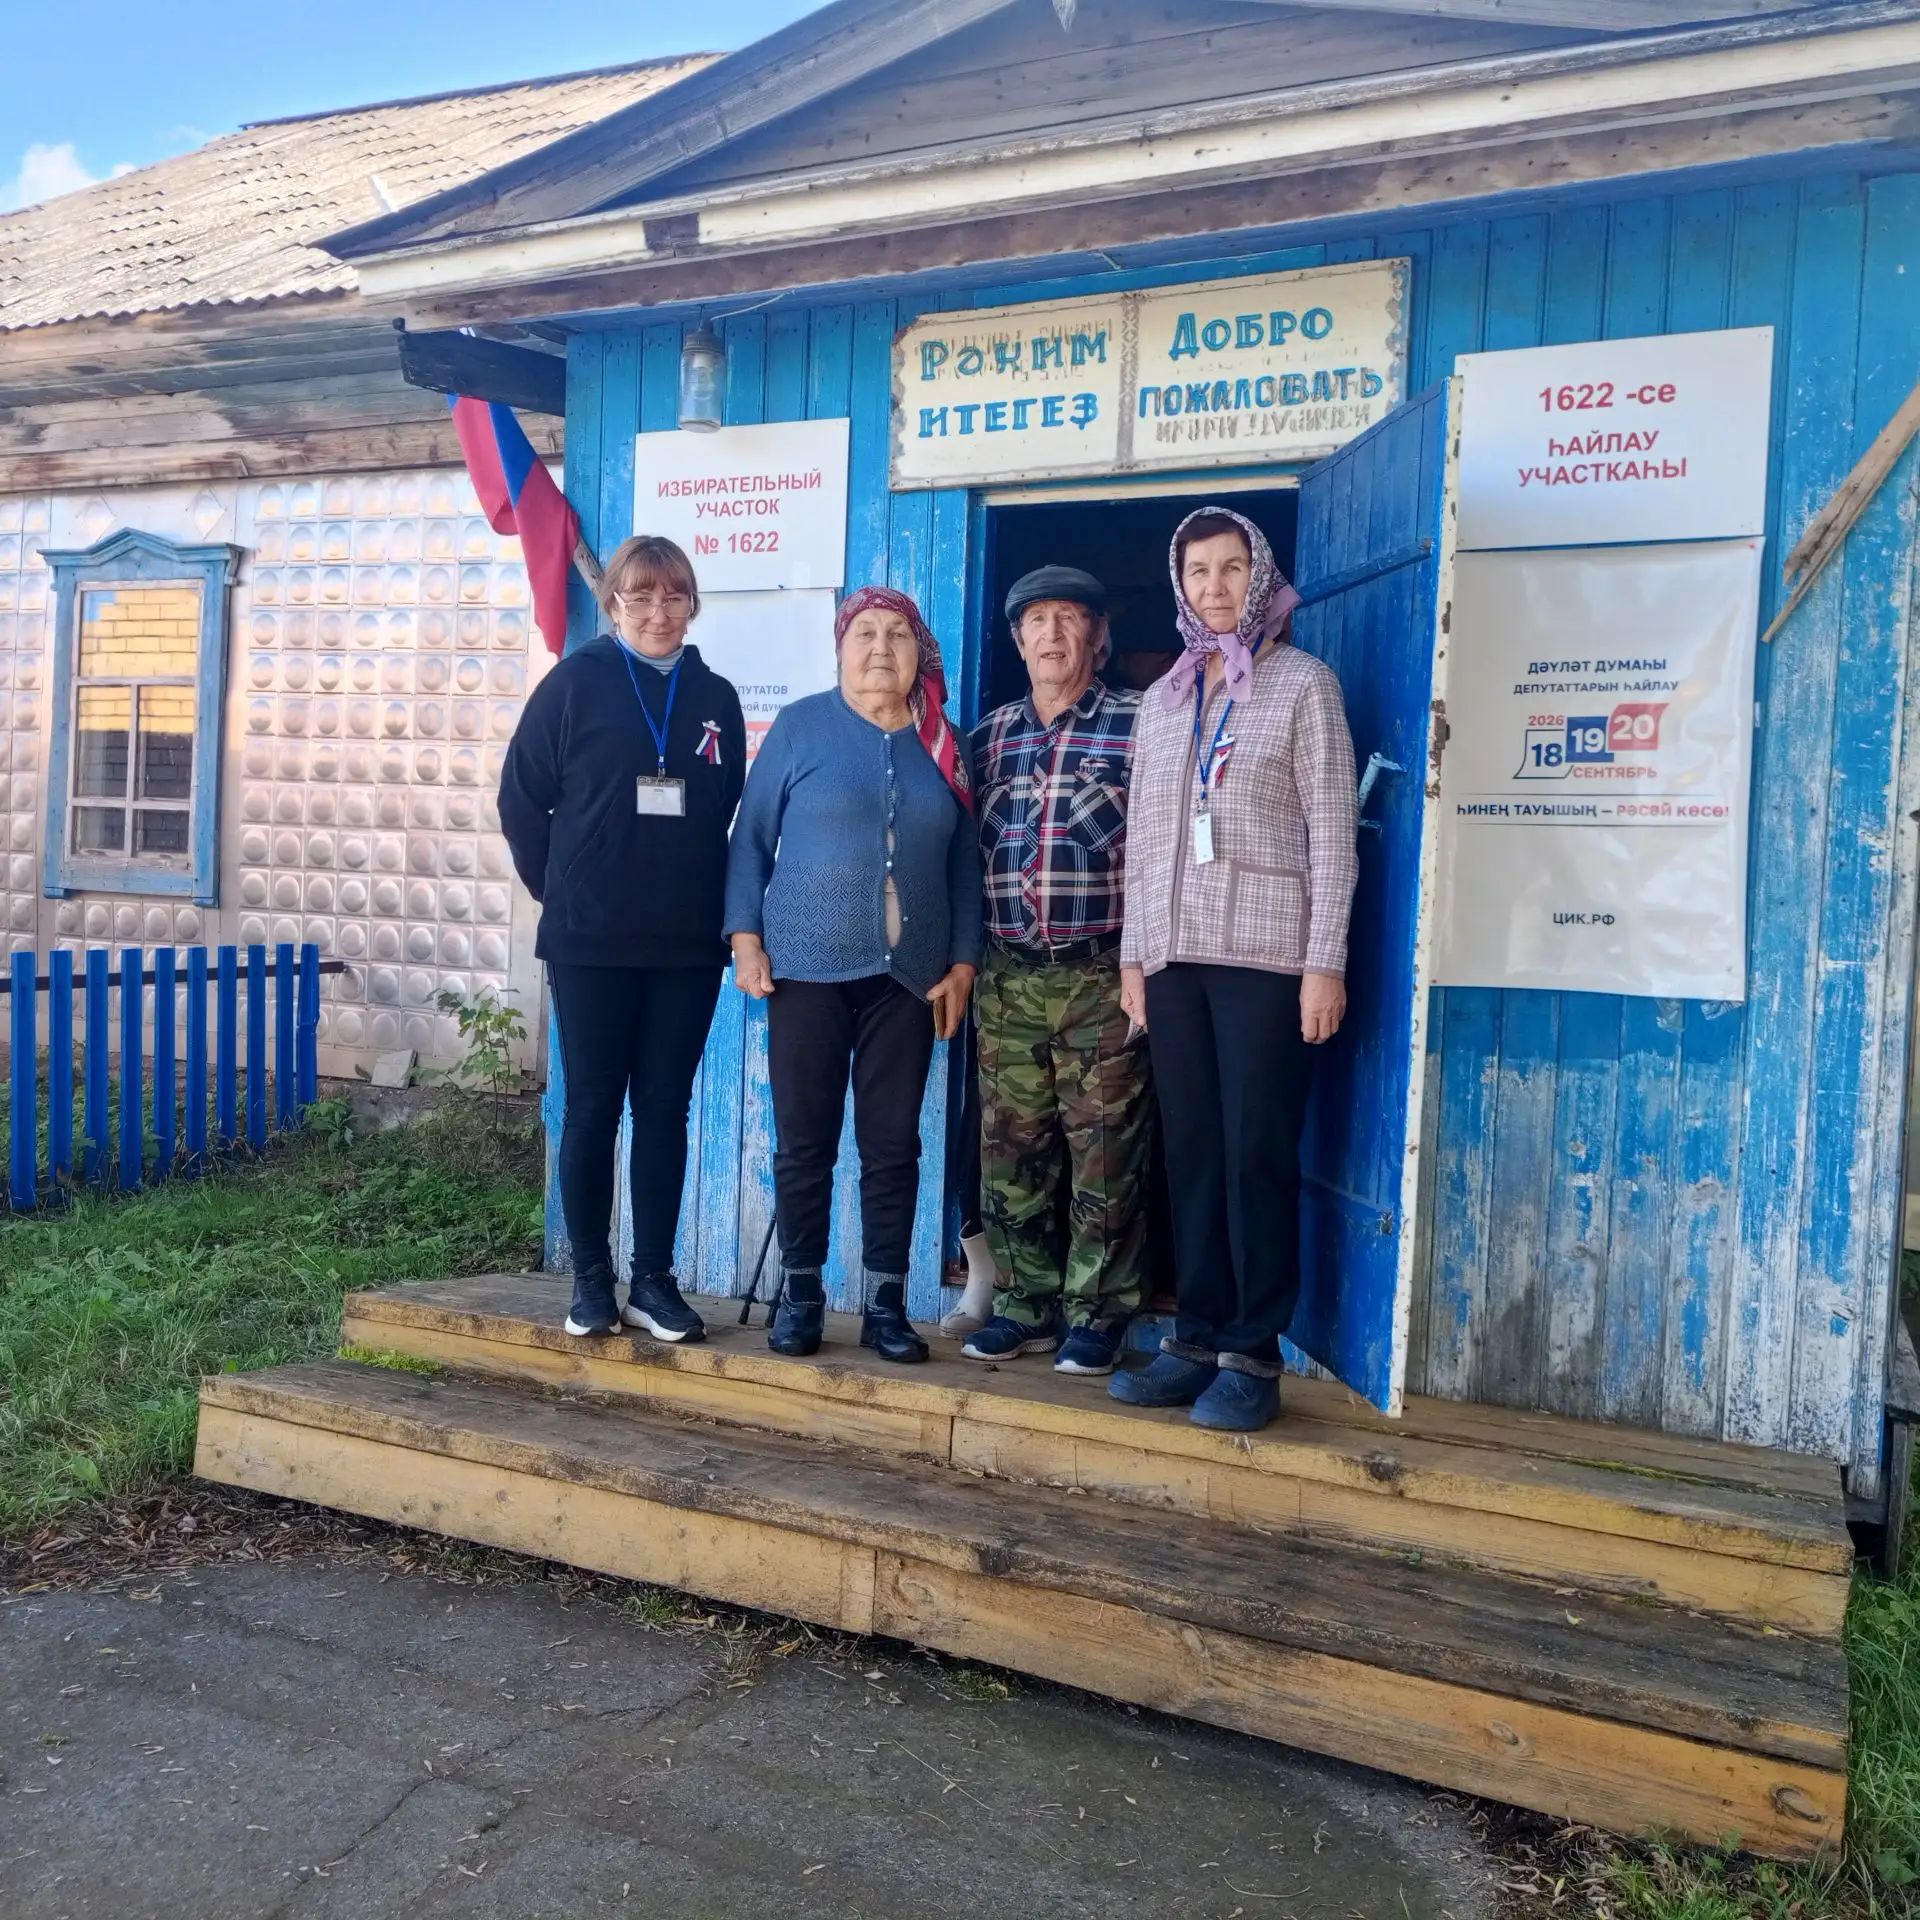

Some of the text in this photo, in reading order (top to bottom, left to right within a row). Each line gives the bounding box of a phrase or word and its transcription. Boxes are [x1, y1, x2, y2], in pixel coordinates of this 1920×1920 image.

[1168, 307, 1333, 361] ДОБРО
[1138, 367, 1383, 418] ПОЖАЛОВАТЬ
[1538, 382, 1614, 412] 1622
[1548, 430, 1659, 457] ҺАЙЛАУ
[1518, 457, 1687, 487] УЧАСТКАҺЫ
[657, 468, 821, 498] ИЗБИРАТЕЛЬНЫЙ
[695, 498, 780, 518] УЧАСТОК
[694, 531, 779, 555] № 1622
[1594, 659, 1667, 674] ДУМАҺЫ
[734, 685, 788, 695] ПУТАТОВ
[1513, 679, 1680, 695] ДЕПУТАТТАРЫН ҺАЙЛАУ
[762, 703, 785, 712] ДУМ
[1528, 715, 1565, 726] 2026
[1531, 714, 1655, 767] 18 19 20
[1573, 767, 1658, 779] СЕНТЯБРЬ
[1456, 804, 1509, 816] ҺИНЕҢ
[1553, 913, 1616, 926] ЦИК.РФ
